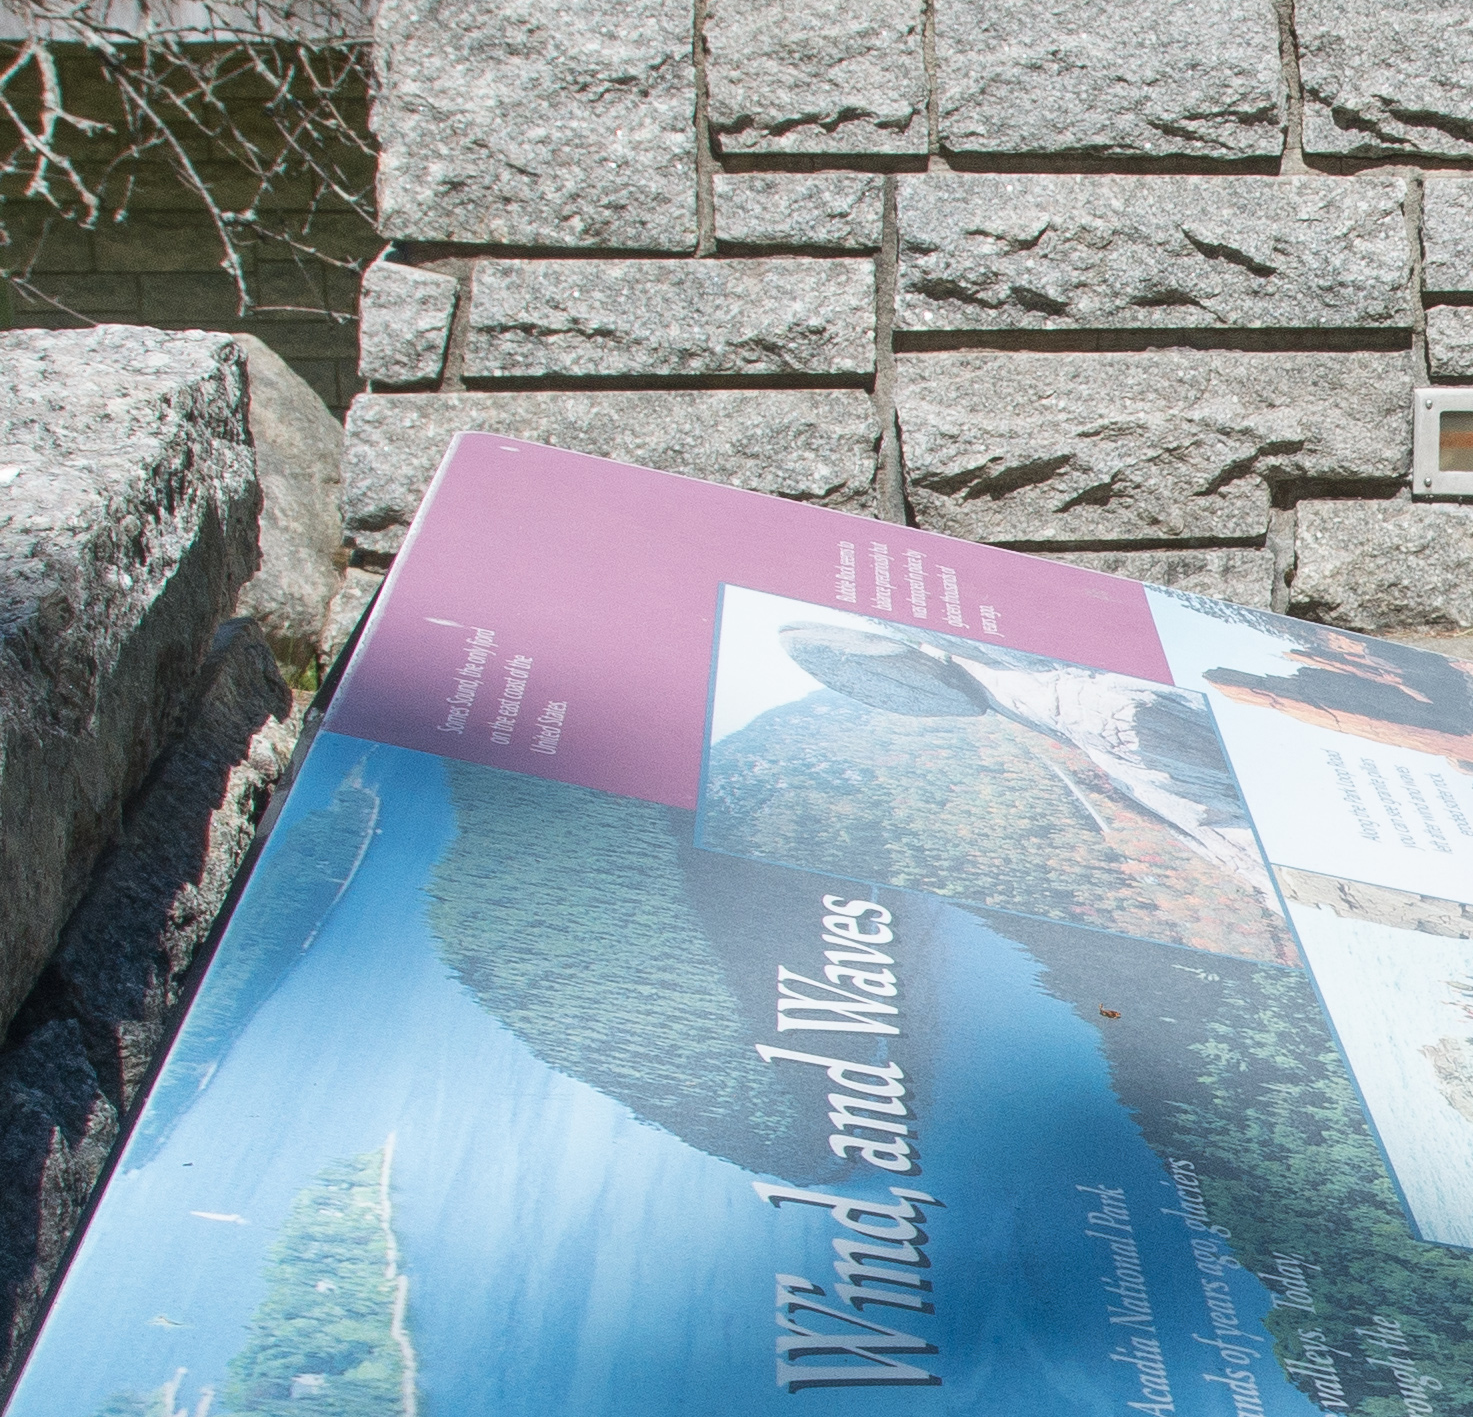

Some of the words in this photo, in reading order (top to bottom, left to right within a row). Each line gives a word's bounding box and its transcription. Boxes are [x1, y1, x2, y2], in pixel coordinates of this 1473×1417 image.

[836, 541, 855, 550] to
[868, 541, 888, 554] but
[902, 548, 928, 560] by
[840, 549, 855, 567] seems
[902, 558, 929, 576] place
[834, 564, 856, 582] Rock
[868, 553, 898, 590] precariously
[935, 564, 957, 575] of
[835, 580, 857, 603] Bubble
[870, 586, 893, 611] balance
[904, 578, 932, 607] dropped
[936, 573, 960, 604] thousands
[911, 605, 928, 619] was
[940, 602, 970, 629] glaciers
[466, 626, 499, 648] fjord
[981, 617, 1005, 638] years
[463, 647, 497, 665] only
[505, 654, 534, 670] the
[455, 663, 485, 678] the
[503, 666, 529, 679] of
[446, 677, 484, 707] Sound,
[503, 677, 527, 700] coast
[498, 698, 522, 717] east
[537, 700, 568, 726] States.
[437, 706, 470, 735] Somes
[487, 716, 516, 732] the
[490, 730, 511, 745] on
[529, 723, 562, 755] United
[1320, 748, 1346, 769] Road
[1359, 757, 1390, 780] pillars
[1334, 768, 1357, 789] Loop
[1394, 764, 1418, 787] waves
[1424, 772, 1448, 789] rock
[1338, 788, 1363, 805] Park
[1368, 778, 1402, 806] granite
[1400, 785, 1426, 804] and
[1435, 788, 1460, 811] softer
[1348, 804, 1370, 819] the
[1383, 804, 1403, 819] see
[1409, 800, 1436, 822] wind
[1358, 817, 1382, 843] Along
[1390, 818, 1410, 834] can
[1423, 822, 1447, 841] after
[1398, 832, 1426, 852] you
[1429, 840, 1454, 855] left
[776, 893, 901, 1035] Waves
[754, 1043, 913, 1173] and
[1075, 1184, 1133, 1234] Park
[1160, 1157, 1232, 1239] glaciers
[1190, 1238, 1241, 1277] ago,
[753, 1181, 940, 1390] Wind,
[1085, 1229, 1157, 1334] National
[1258, 1252, 1321, 1314] Today,
[1200, 1278, 1265, 1343] years
[1353, 1315, 1410, 1352] the
[1192, 1333, 1262, 1365] of
[1109, 1336, 1175, 1417] Acadia
[1283, 1327, 1352, 1408] valleys.
